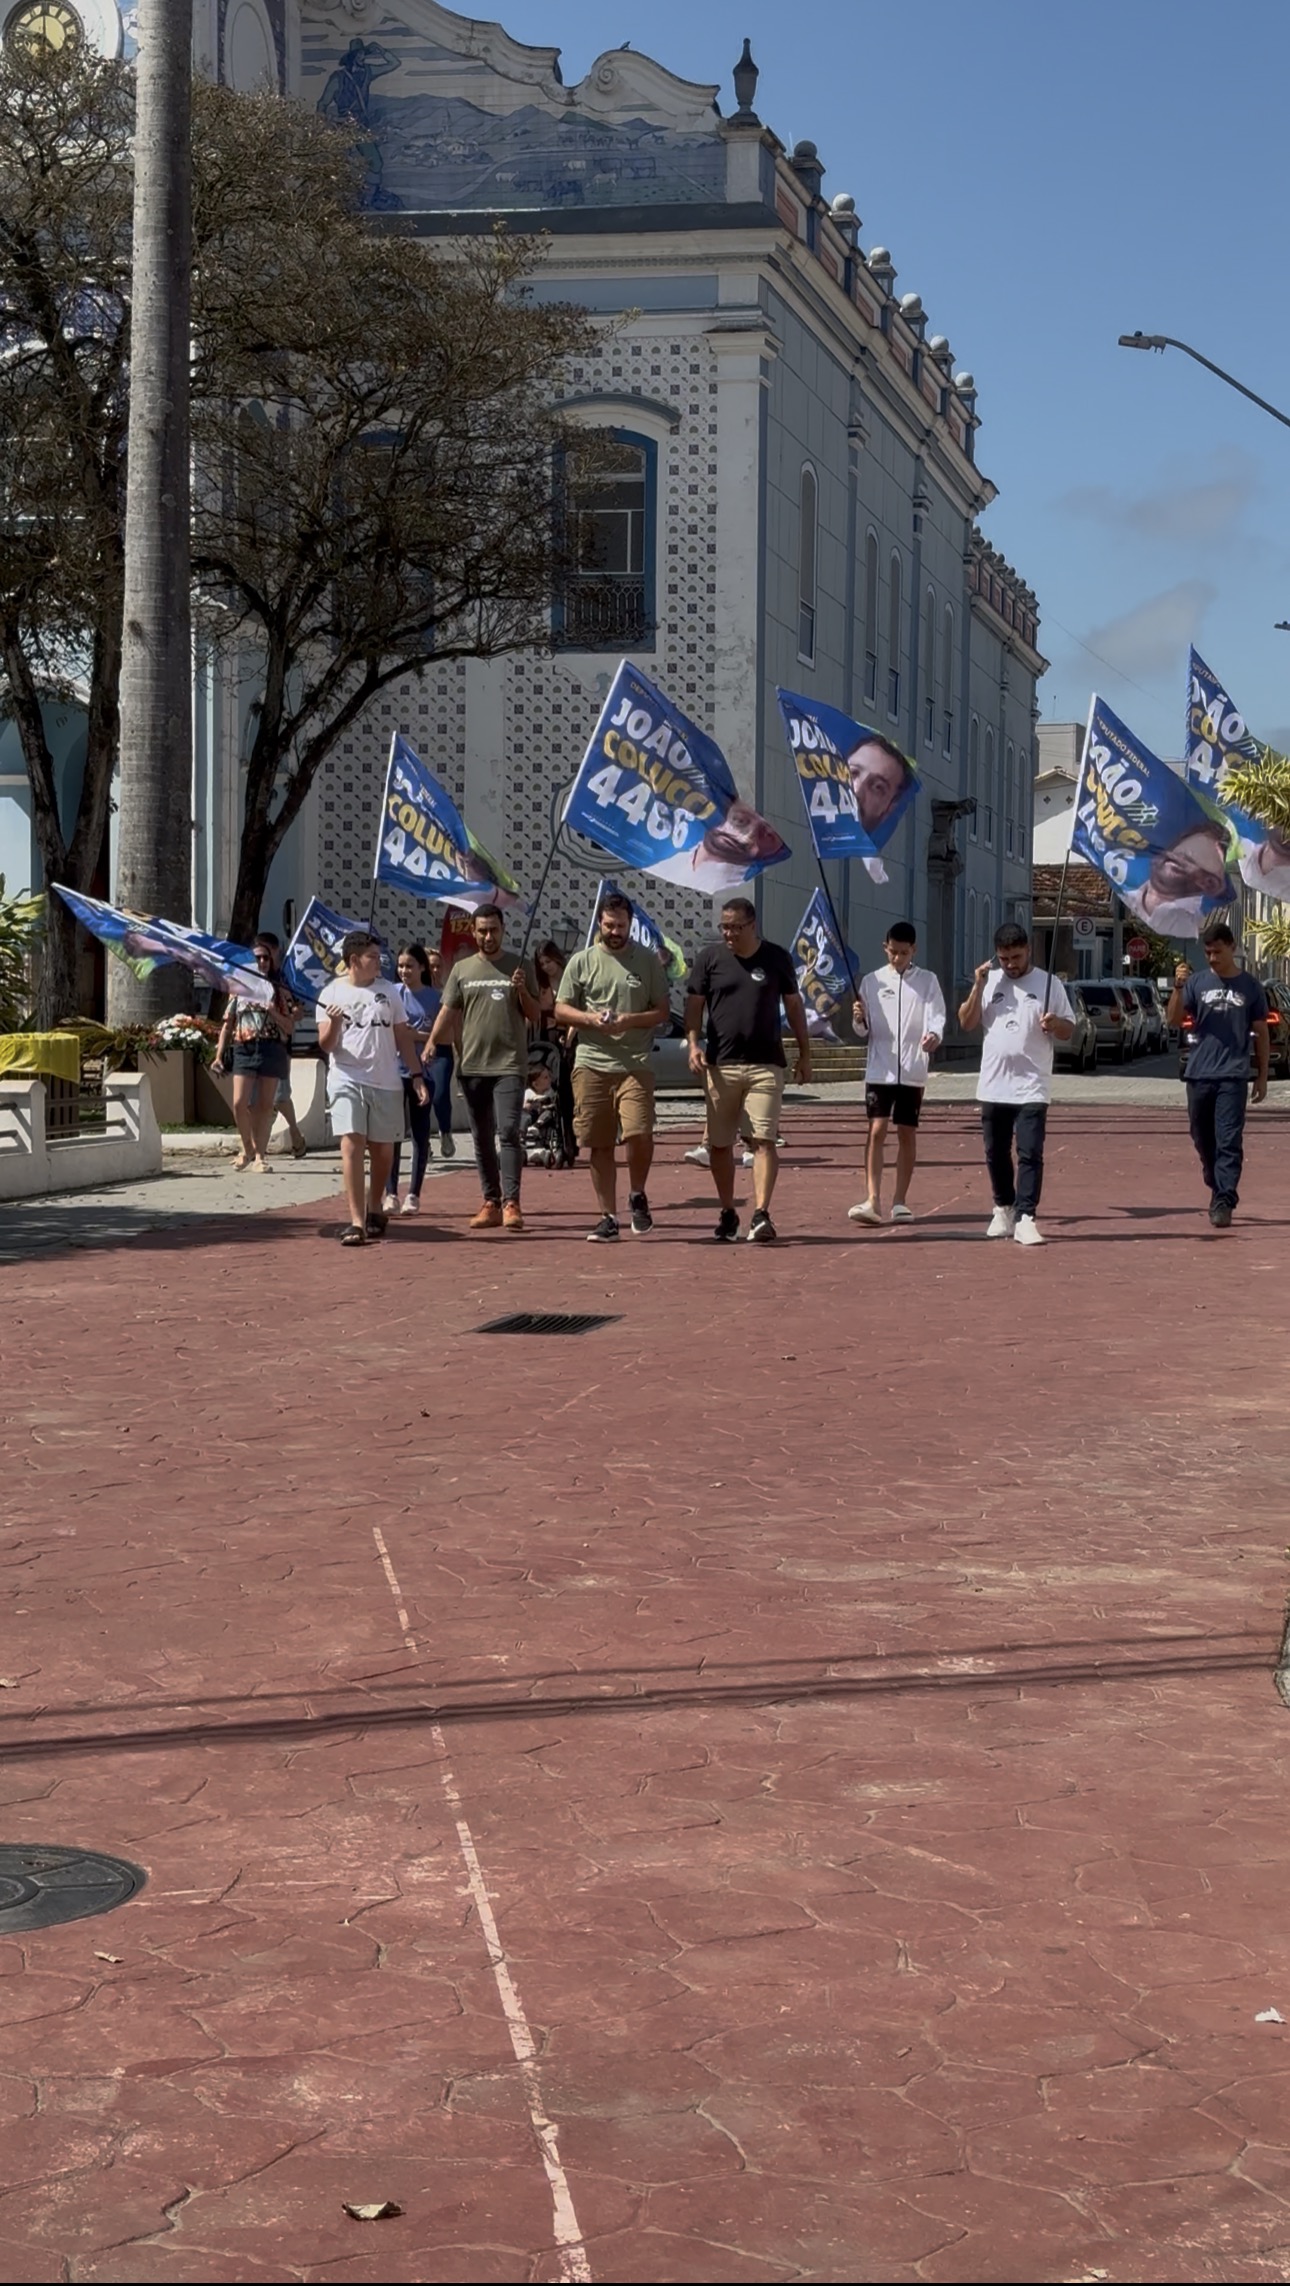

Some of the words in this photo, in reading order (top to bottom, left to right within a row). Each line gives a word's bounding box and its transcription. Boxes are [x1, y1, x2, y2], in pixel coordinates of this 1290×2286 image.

[610, 697, 694, 770] JOÃO
[1125, 749, 1151, 778] FEDERAL
[587, 764, 696, 848] 4466
[603, 729, 718, 820] COLUCCI
